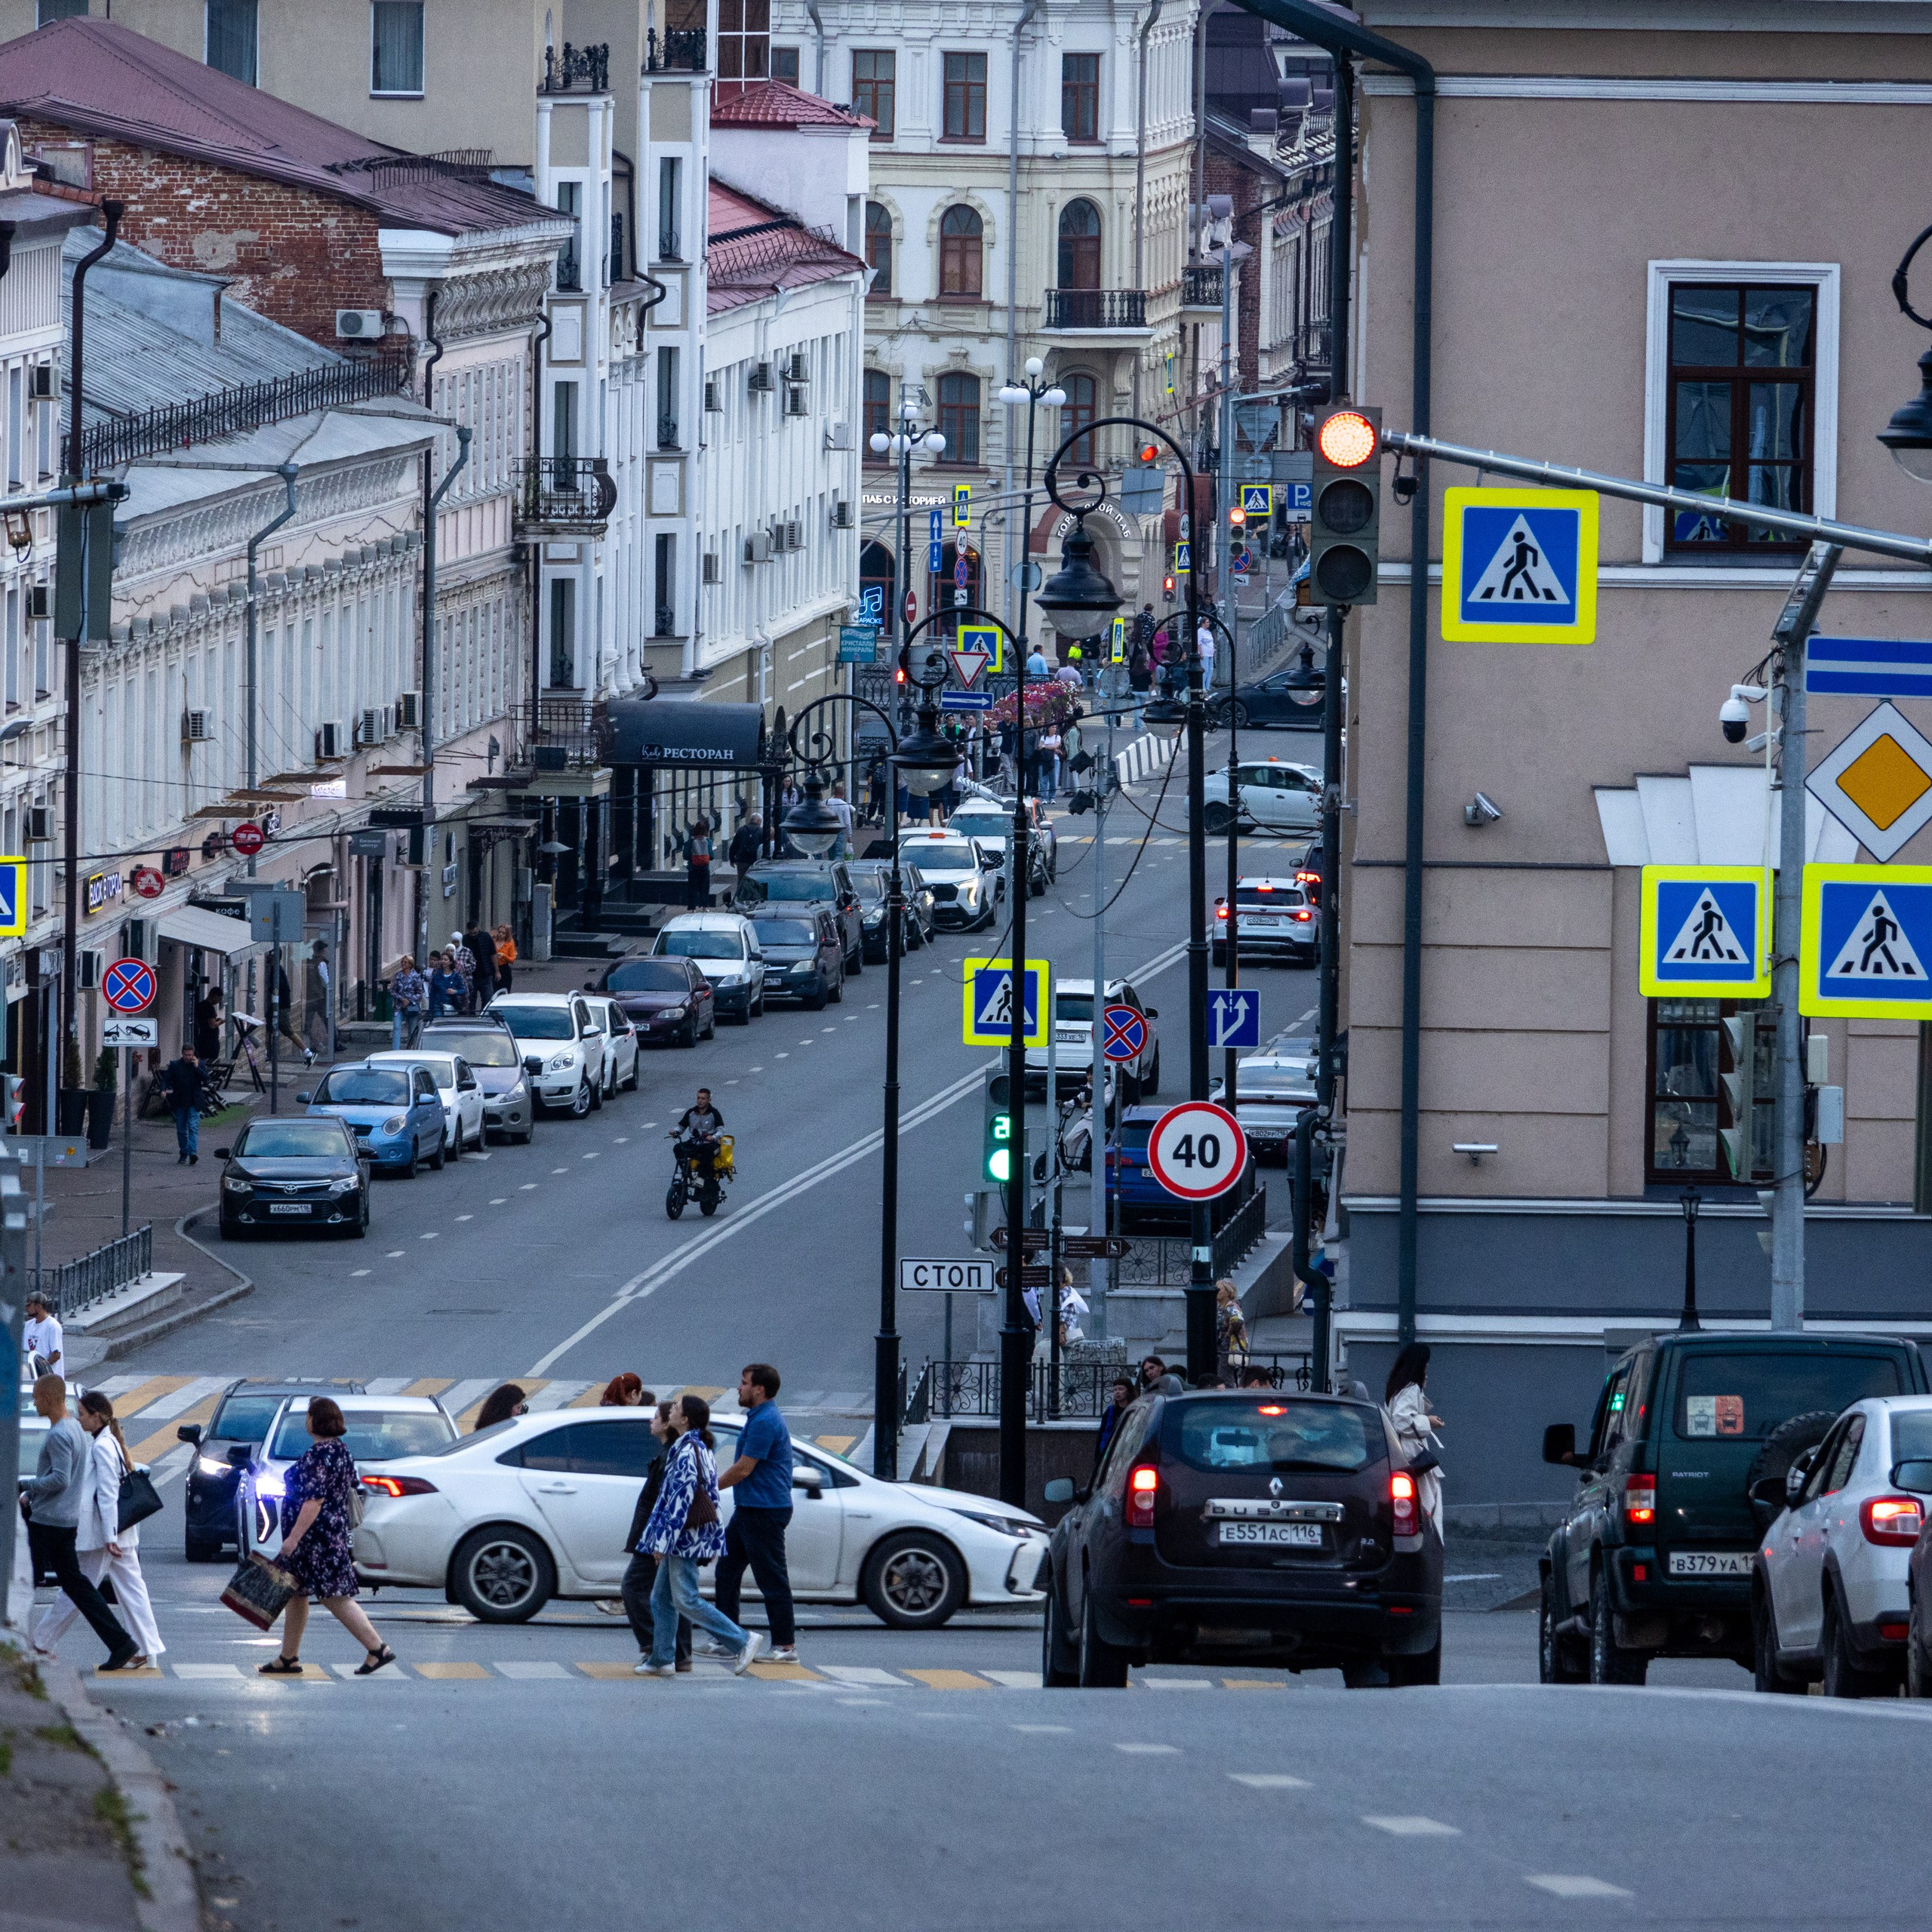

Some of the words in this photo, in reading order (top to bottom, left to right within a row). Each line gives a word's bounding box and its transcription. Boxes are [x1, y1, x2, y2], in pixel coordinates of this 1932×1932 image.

[862, 494, 882, 503] ПАБ
[883, 495, 891, 504] С
[1115, 513, 1131, 537] ПАБ
[958, 537, 965, 548] 40
[663, 747, 734, 760] РЕСТОРАН
[215, 907, 240, 916] кафе
[1172, 1134, 1220, 1168] 40
[914, 1265, 981, 1287] СТОП
[1212, 1506, 1339, 1519] DUSTER
[1226, 1524, 1288, 1541] Е551АС
[1292, 1525, 1315, 1538] 116
[1676, 1555, 1738, 1571] В379УА
